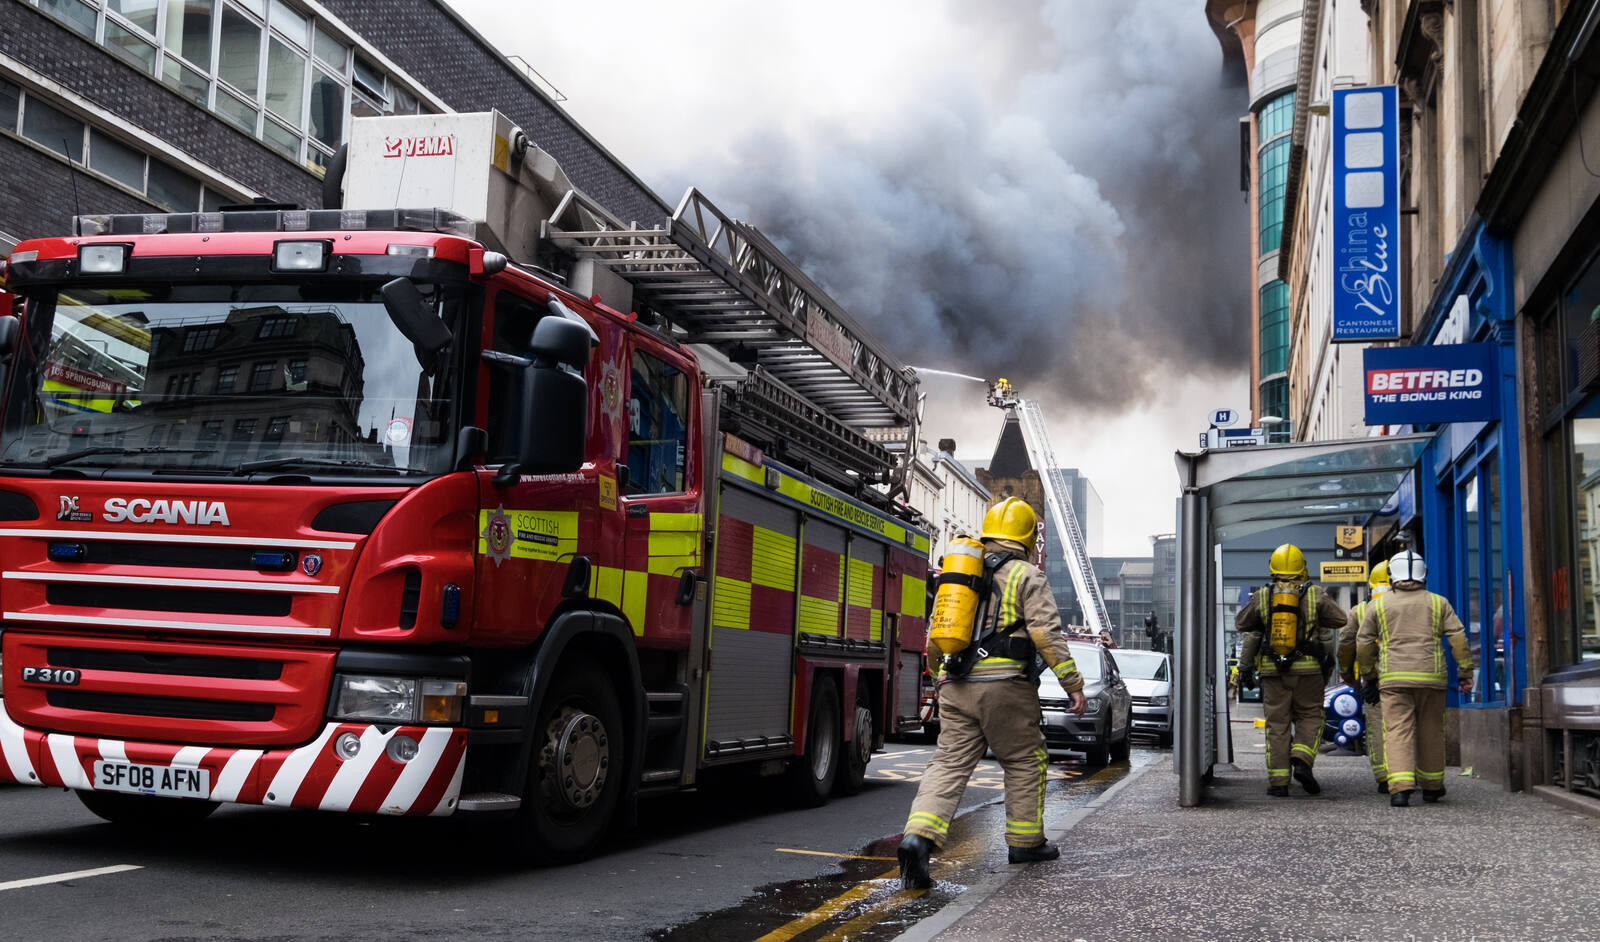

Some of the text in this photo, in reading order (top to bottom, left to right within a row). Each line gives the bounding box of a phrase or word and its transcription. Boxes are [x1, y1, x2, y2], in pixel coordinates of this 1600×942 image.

[405, 136, 453, 157] VEMA
[1340, 212, 1368, 294] China
[1355, 223, 1392, 316] Blue
[65, 370, 111, 392] SPRINGBURN
[1372, 369, 1483, 390] BETFRED
[1372, 390, 1482, 403] THE BONUS KING
[103, 498, 230, 526] SCANIA
[811, 489, 834, 513] SCOTTISH
[835, 499, 844, 518] FIRE
[844, 504, 854, 521] AND
[518, 514, 560, 535] SCOTTISH
[23, 667, 75, 683] P 310
[102, 764, 200, 792] SF08 AFN
